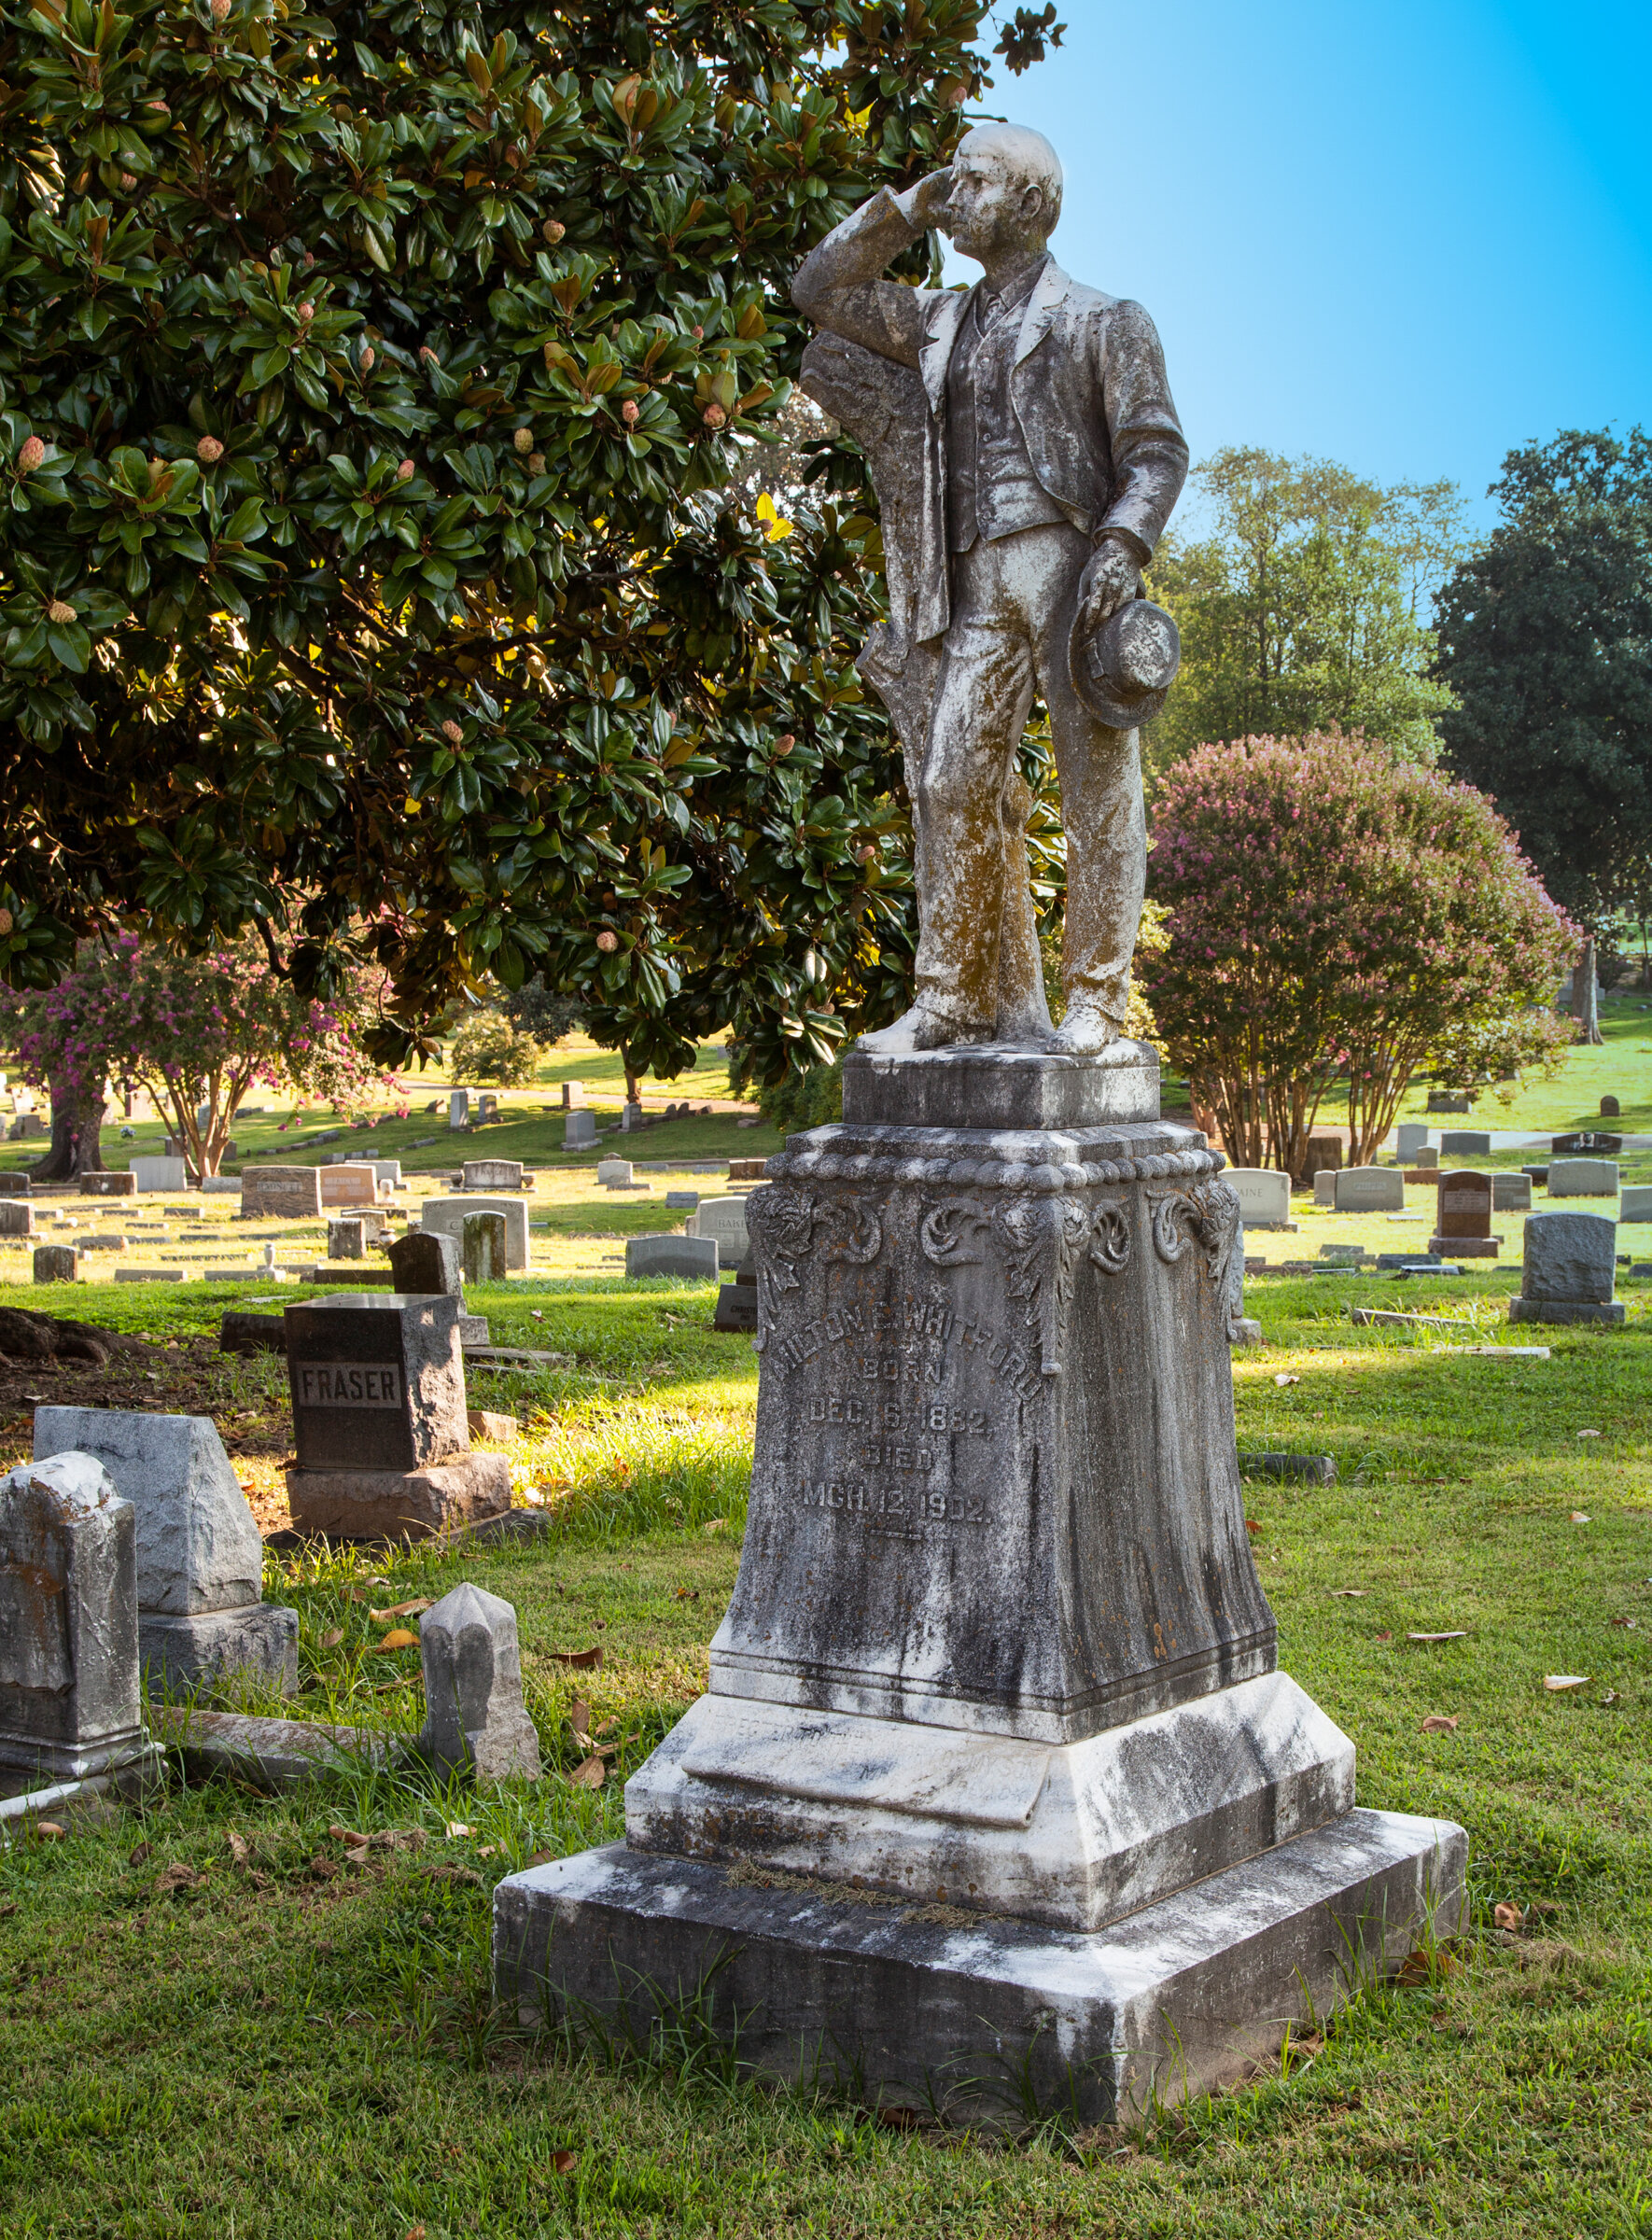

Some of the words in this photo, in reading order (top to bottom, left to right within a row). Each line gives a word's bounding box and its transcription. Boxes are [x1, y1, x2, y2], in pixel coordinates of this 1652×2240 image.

[718, 1218, 748, 1229] BAKE
[768, 1306, 865, 1382] MILTON
[902, 1301, 1043, 1401] WHITFORD
[301, 1369, 395, 1400] FRASER
[862, 1358, 941, 1384] BORN
[810, 1397, 870, 1425] DEC.
[884, 1402, 909, 1433] 6,
[863, 1446, 932, 1471] DIED
[878, 1490, 911, 1520] 12,
[919, 1492, 992, 1525] 1902.
